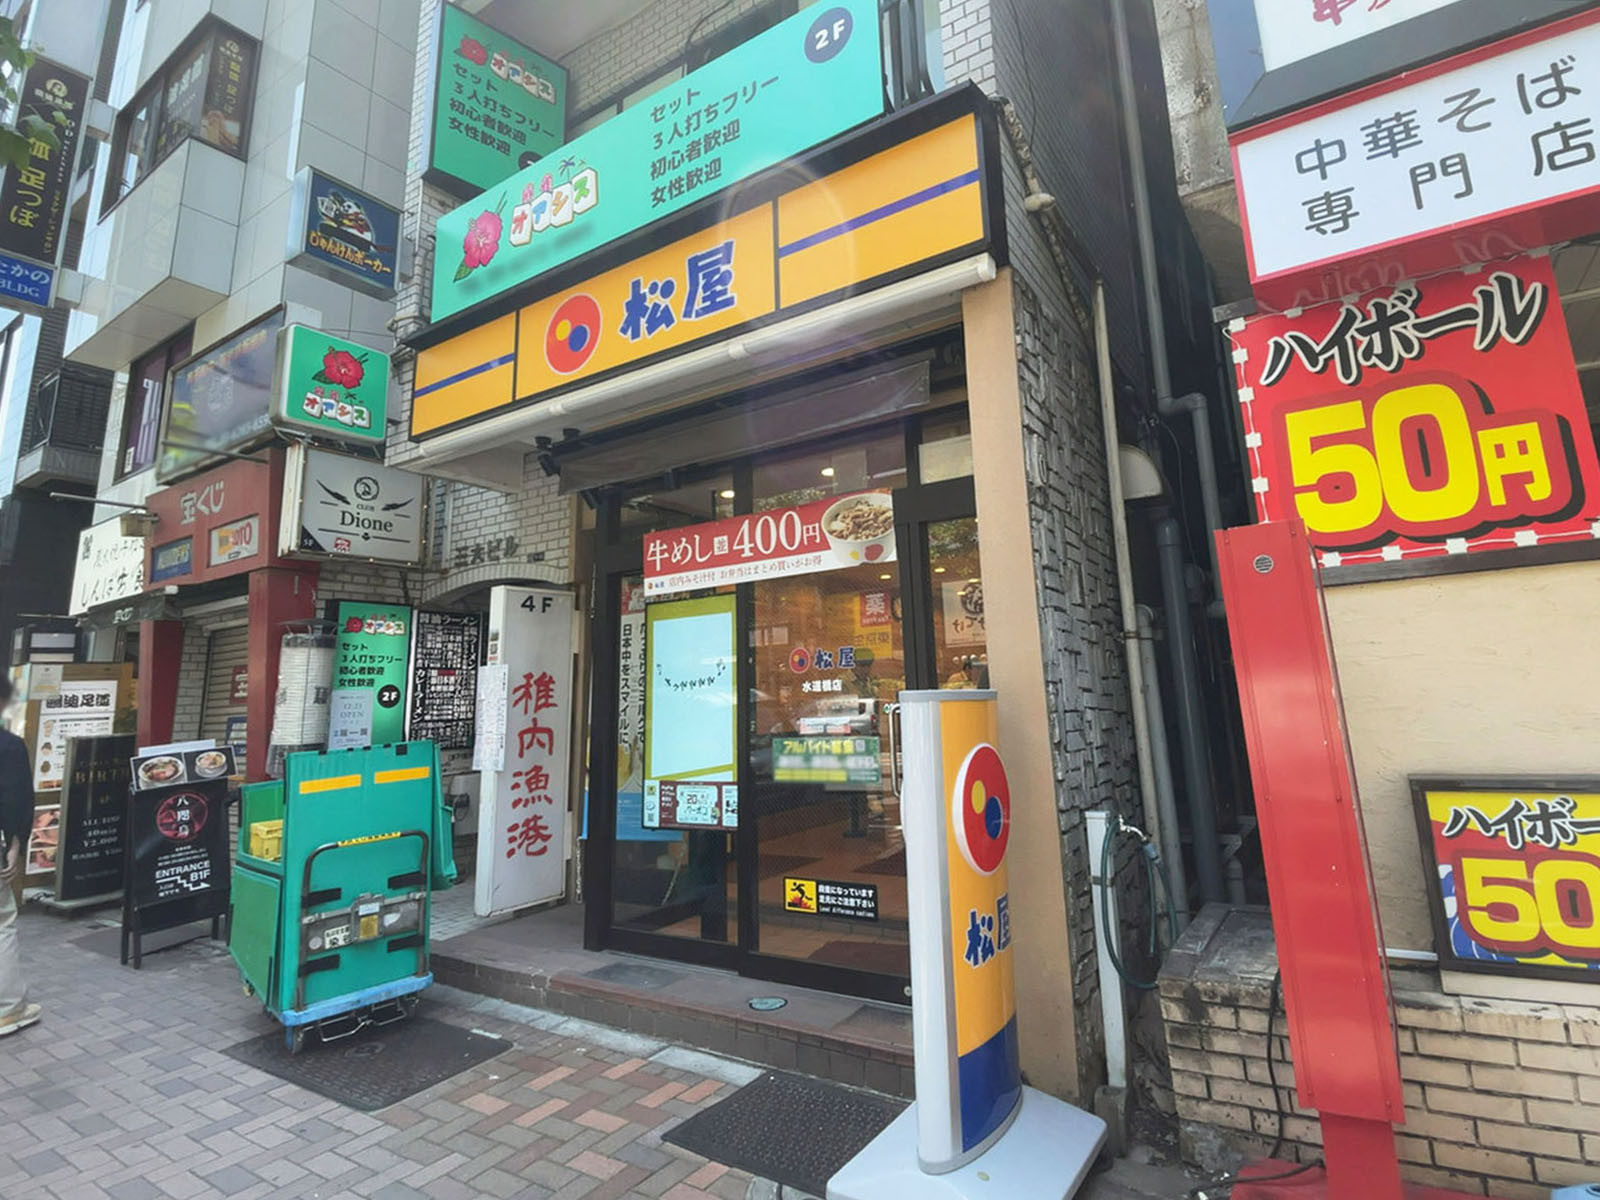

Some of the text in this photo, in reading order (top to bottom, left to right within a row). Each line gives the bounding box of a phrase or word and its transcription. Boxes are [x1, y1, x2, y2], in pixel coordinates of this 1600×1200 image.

[815, 19, 845, 50] 2F
[454, 62, 498, 92] セット
[490, 53, 555, 104] オアシス
[449, 97, 526, 145] 初心者歓迎
[650, 88, 700, 123] セット
[653, 76, 779, 150] 3人打ちフリー
[1295, 55, 1581, 181] 中華そば
[448, 115, 510, 156] 女性歓迎
[650, 118, 741, 181] 初心者歓迎
[650, 157, 722, 208] 女性歓迎
[1302, 118, 1595, 235] 専門店
[511, 172, 596, 243] オアシス
[619, 238, 738, 342] 松屋
[1259, 272, 1548, 386] ハイボール
[303, 392, 371, 428] オアシス
[1286, 384, 1553, 533] 50円
[181, 481, 225, 525] 宝くじ
[340, 510, 393, 533] Dione
[647, 534, 712, 572] 牛めし
[733, 511, 820, 558] 400円
[520, 595, 553, 613] 4F
[341, 642, 368, 651] セット
[364, 619, 405, 635] オアシス
[339, 666, 385, 676] 初心者歓迎
[814, 646, 857, 669] 松屋
[339, 678, 375, 688] 女性歓迎
[382, 692, 398, 701] 2F
[802, 680, 842, 693] 水道橋店
[507, 671, 559, 859] 稚内漁港
[1442, 797, 1600, 849] ハイボー
[155, 860, 210, 878] ENTRANCE
[190, 869, 211, 882] B1F
[1462, 857, 1600, 948] 50
